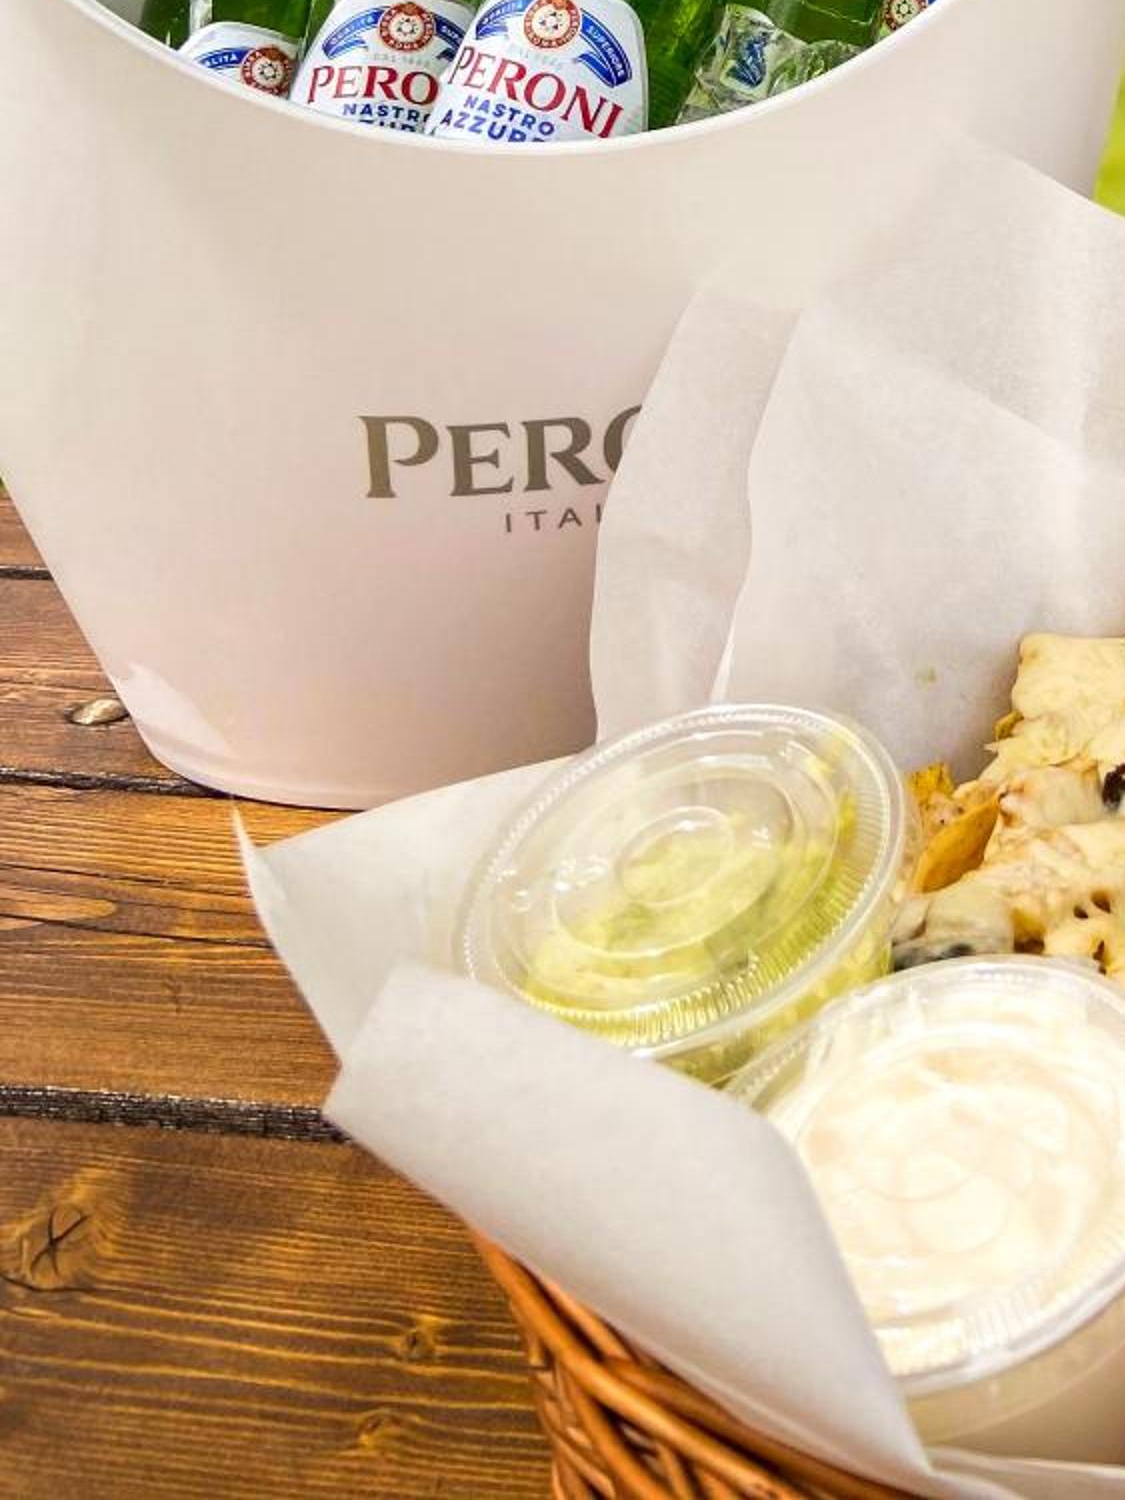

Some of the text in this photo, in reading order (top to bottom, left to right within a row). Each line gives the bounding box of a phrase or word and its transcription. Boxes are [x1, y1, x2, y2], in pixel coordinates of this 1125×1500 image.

[447, 45, 624, 139] PERONI
[440, 109, 545, 143] AZZUR
[463, 95, 555, 136] NASTRO
